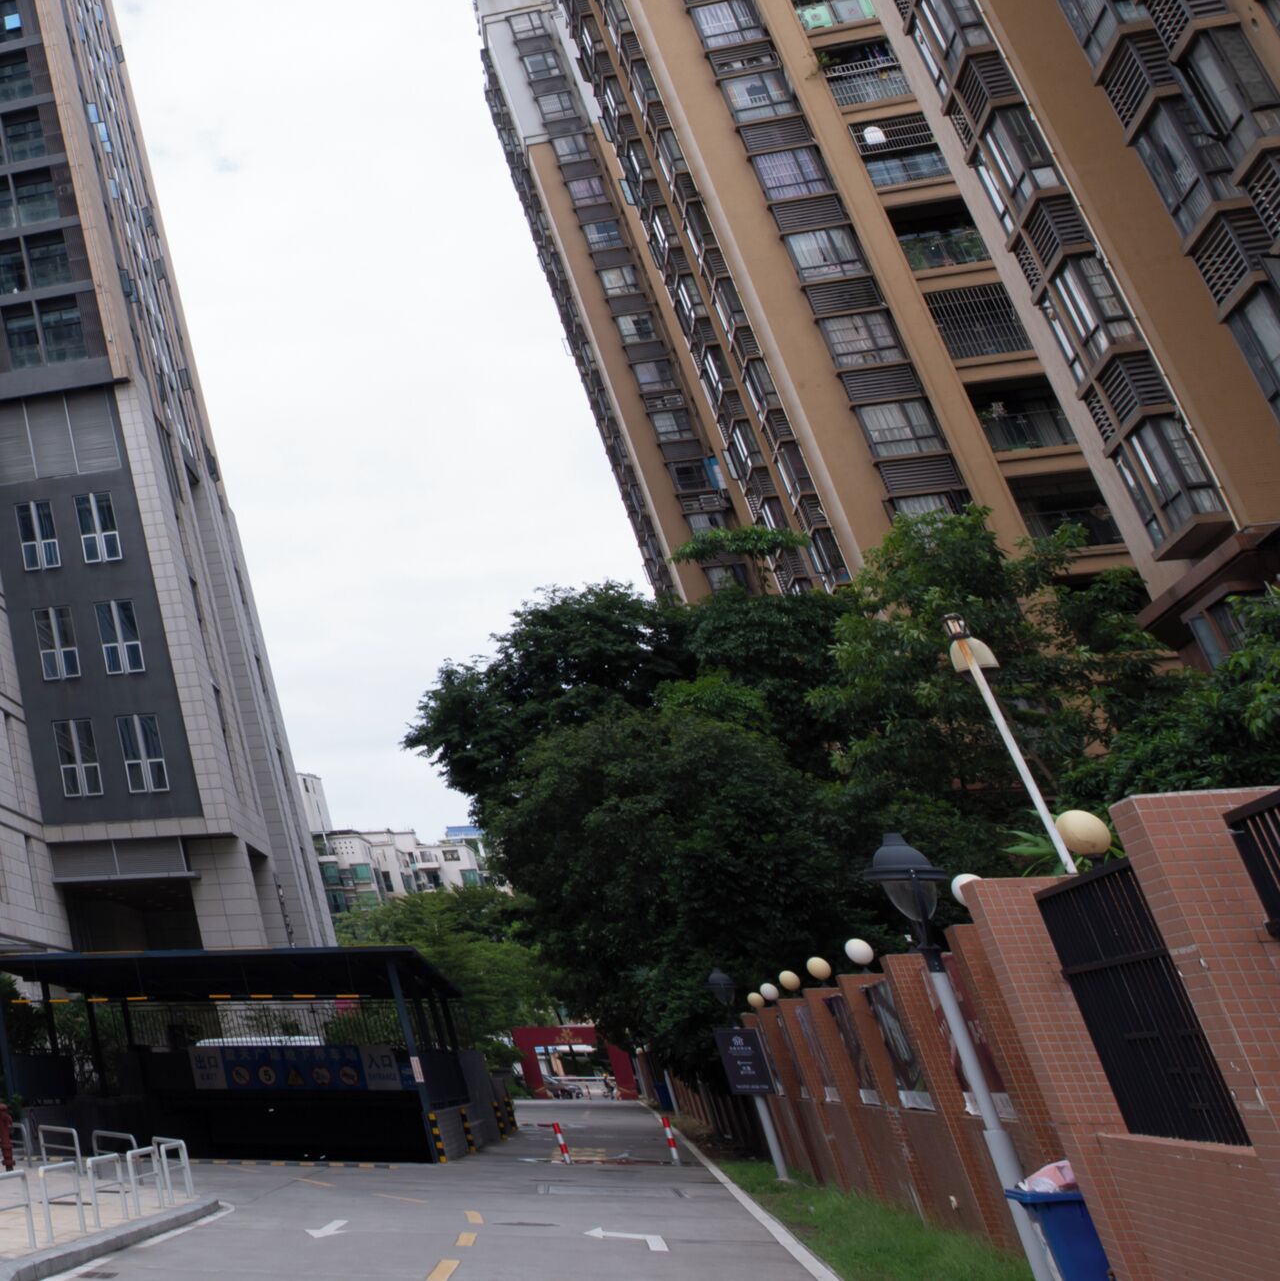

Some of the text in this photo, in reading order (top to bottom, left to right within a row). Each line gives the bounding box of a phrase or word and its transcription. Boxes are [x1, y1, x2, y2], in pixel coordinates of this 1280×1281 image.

[194, 1055, 218, 1069] 出口
[367, 1054, 392, 1068] 入口
[263, 1069, 272, 1081] 5
